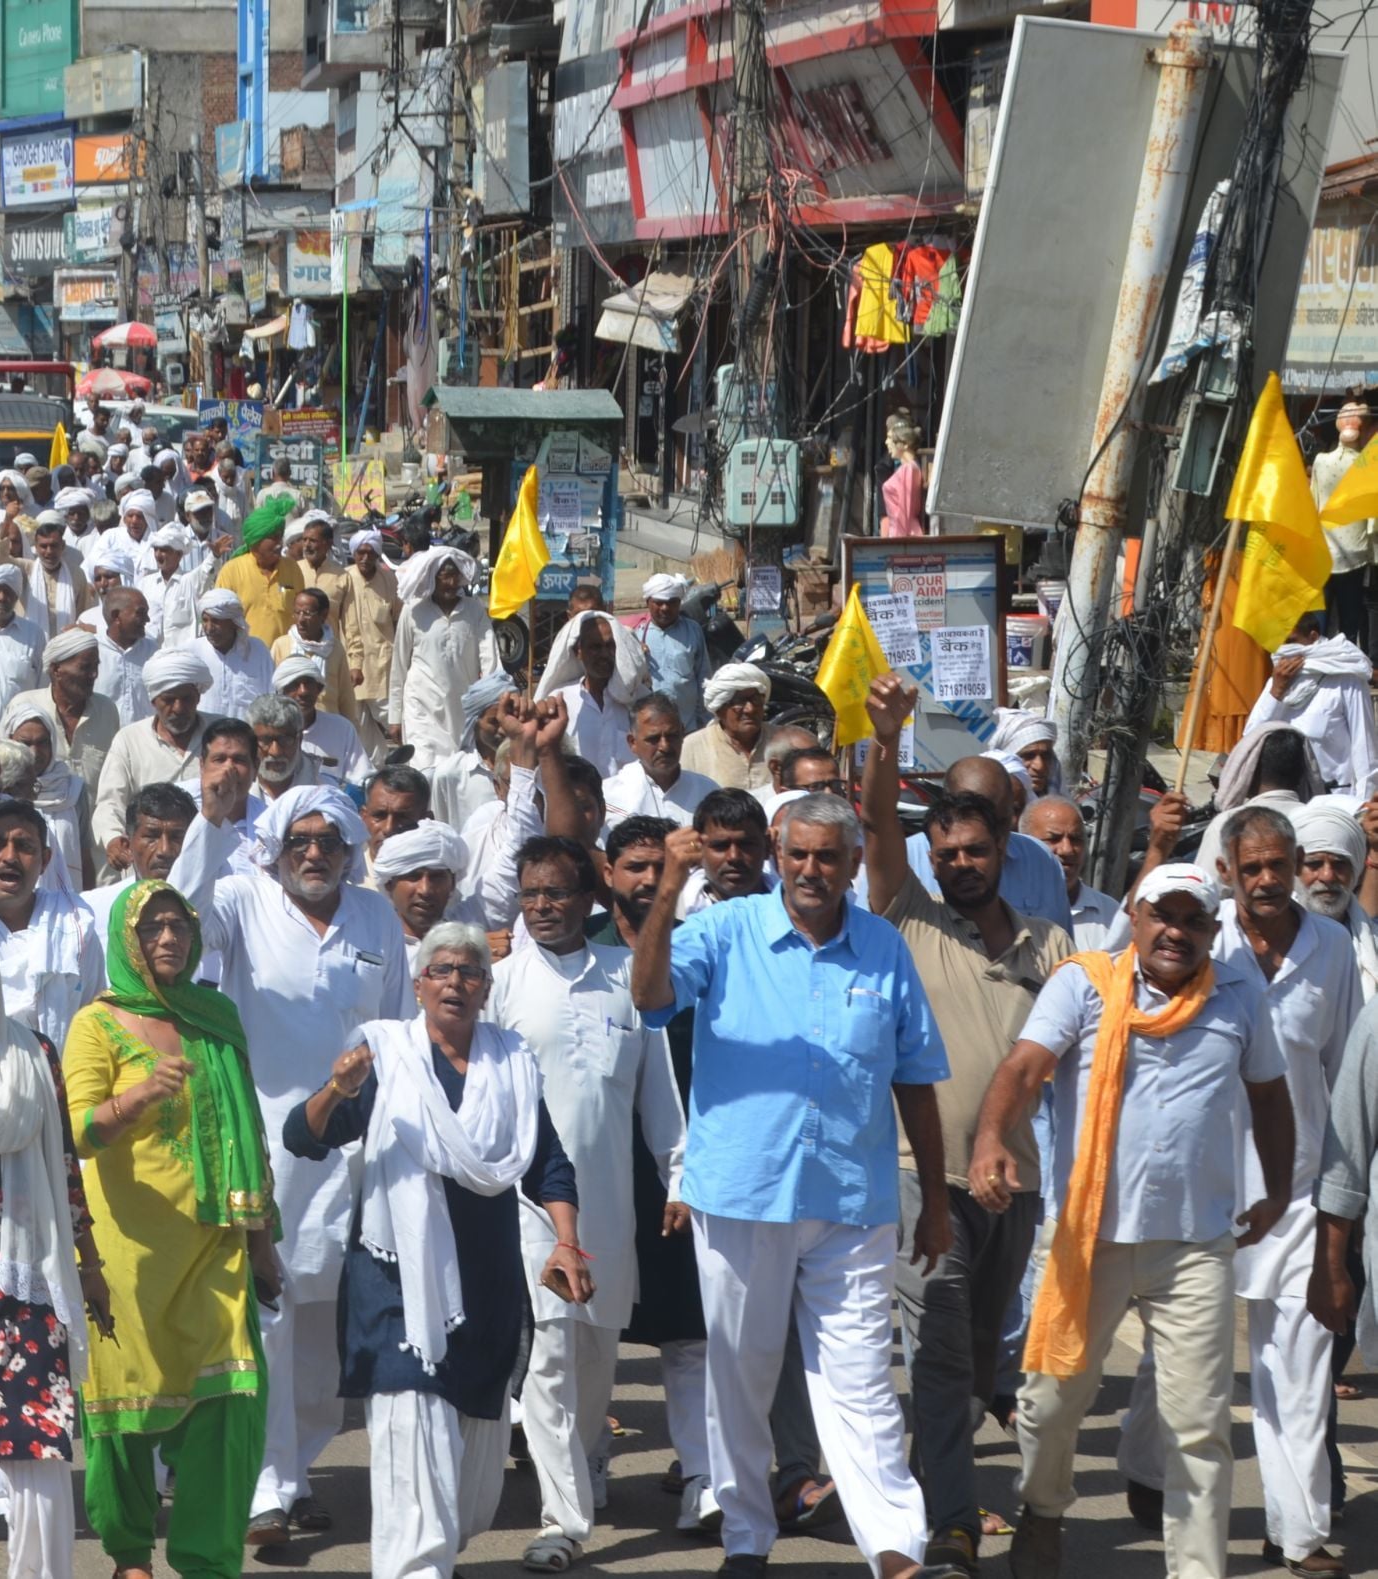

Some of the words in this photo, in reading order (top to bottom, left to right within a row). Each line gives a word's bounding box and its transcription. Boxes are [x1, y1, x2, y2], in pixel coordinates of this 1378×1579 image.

[42, 22, 64, 43] Phone
[12, 143, 41, 167] GADGET
[42, 139, 63, 163] STORE
[269, 439, 315, 460] देशी
[542, 573, 574, 592] ऊपर
[916, 587, 943, 597] AIM
[886, 649, 916, 664] 719058
[939, 683, 986, 697] 9718719058
